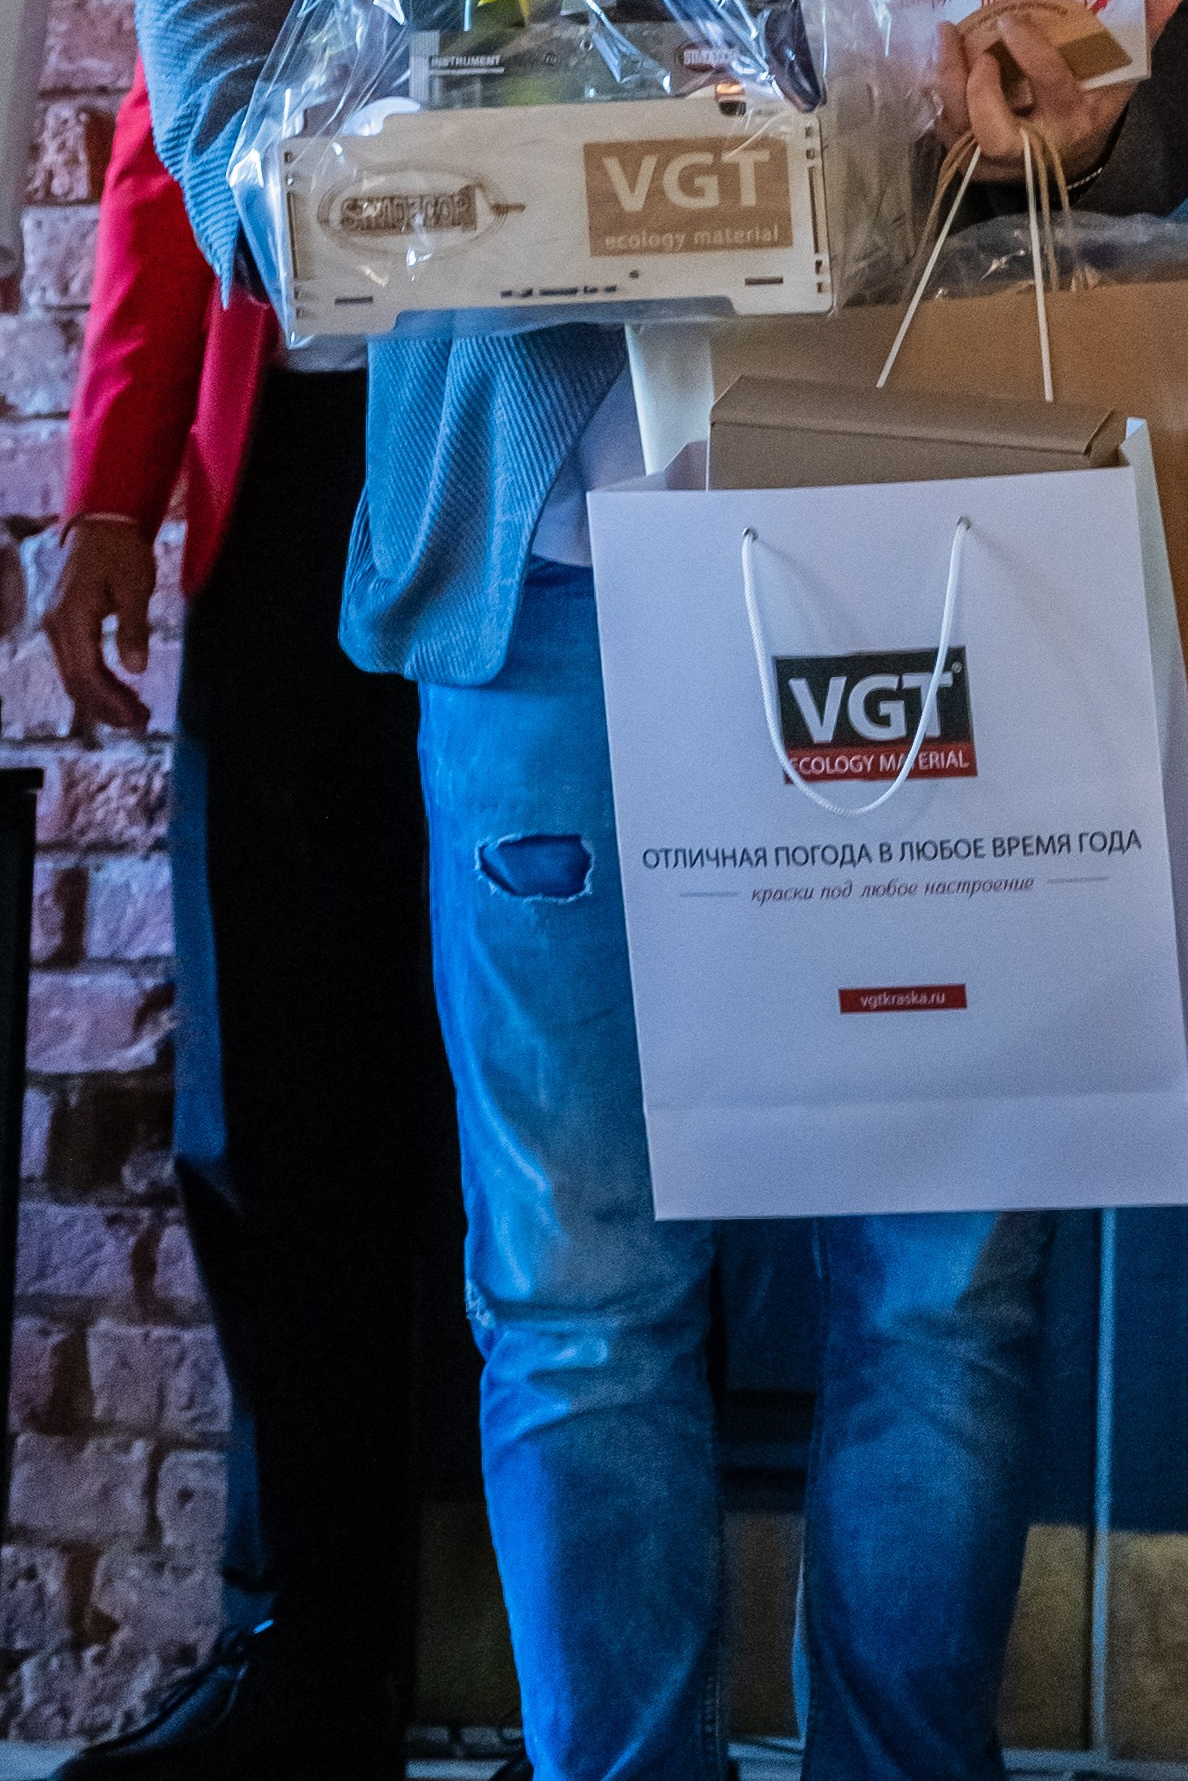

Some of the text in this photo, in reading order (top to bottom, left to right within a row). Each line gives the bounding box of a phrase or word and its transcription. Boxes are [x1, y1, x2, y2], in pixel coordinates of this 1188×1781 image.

[603, 148, 771, 213] VGT
[605, 225, 779, 252] ecology material
[788, 672, 953, 744] VGT
[643, 829, 1142, 869] ОТЛИЧНАЯ ПОГОДА В ЛЮБОЕ ВРЕМЯ ГОДА
[751, 876, 1035, 907] краски под любое настроение
[860, 990, 946, 1010] vgtkraska.ru
